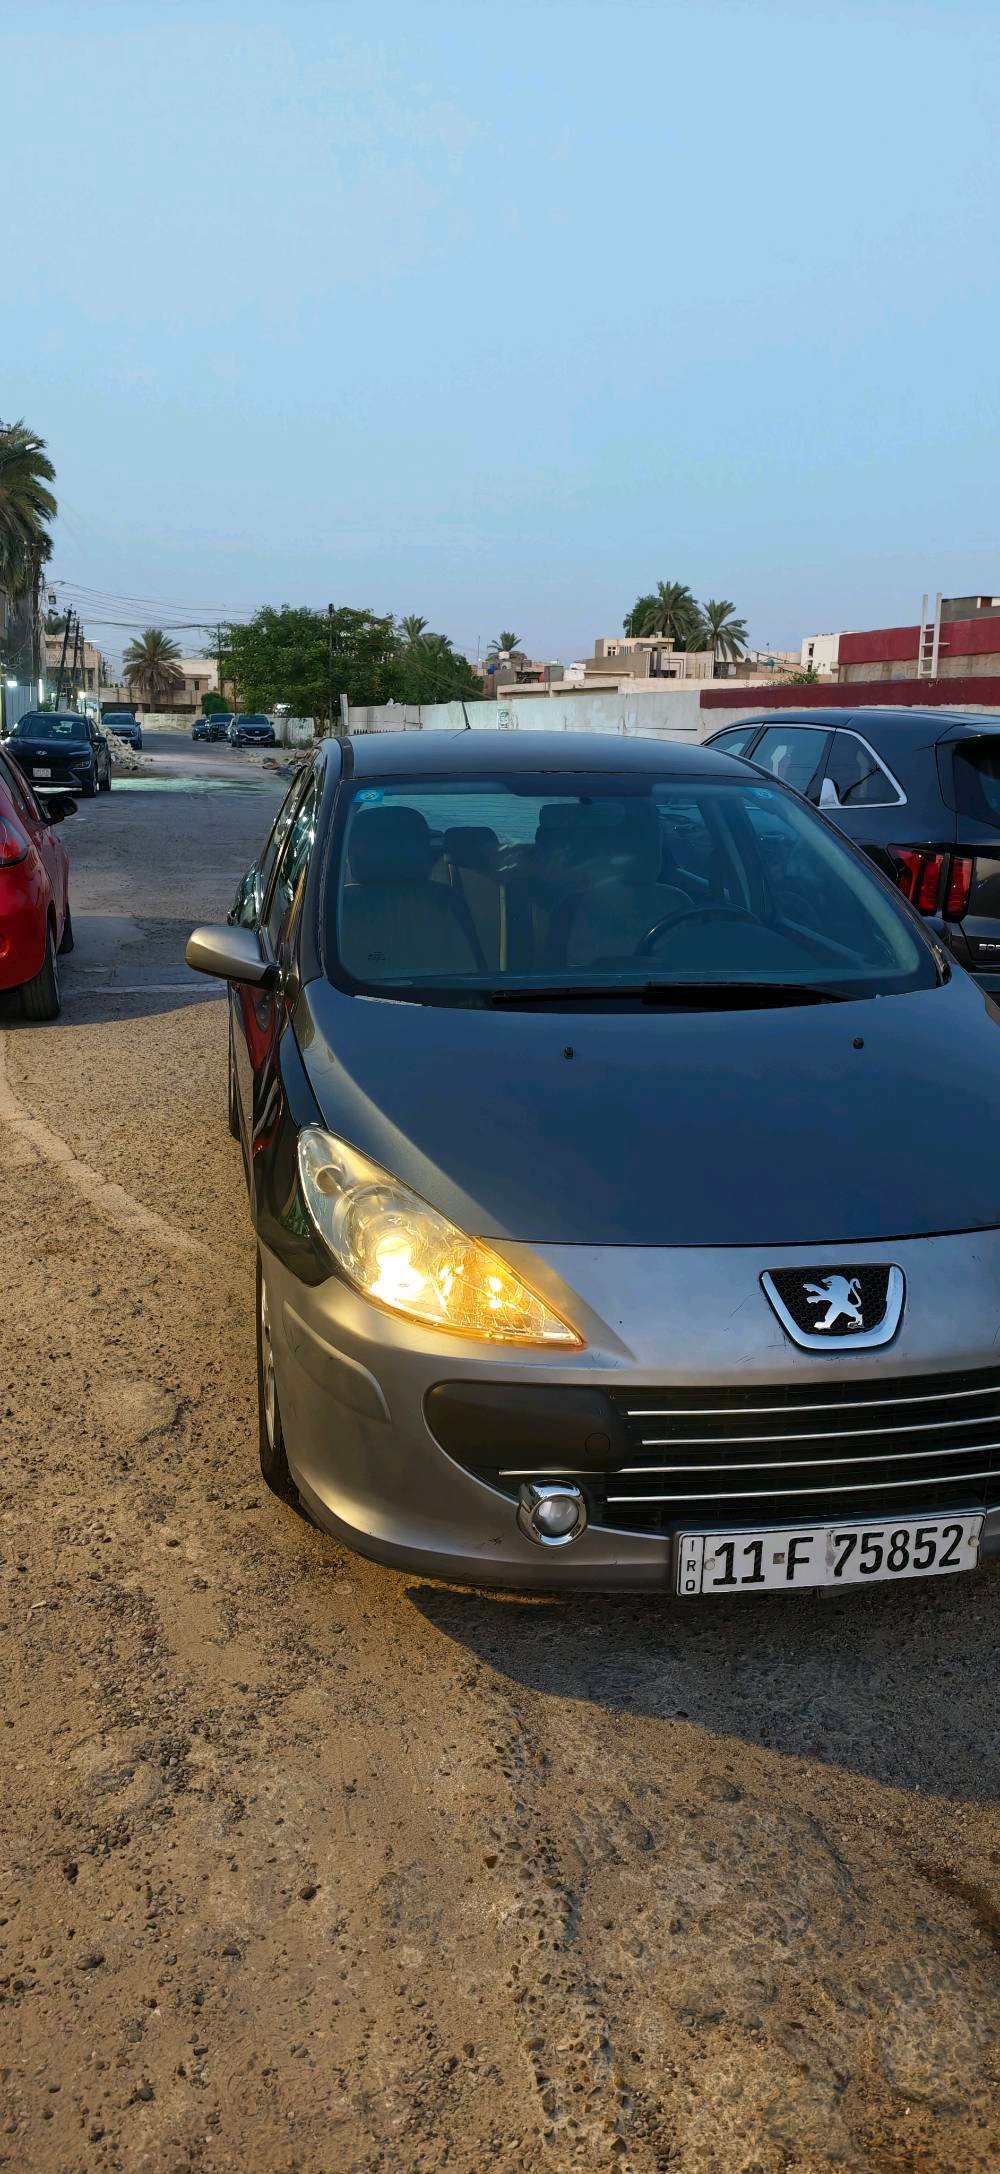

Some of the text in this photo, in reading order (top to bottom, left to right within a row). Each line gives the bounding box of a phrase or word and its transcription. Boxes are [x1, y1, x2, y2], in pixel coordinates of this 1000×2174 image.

[713, 1524, 964, 1585] 11 F 75852
